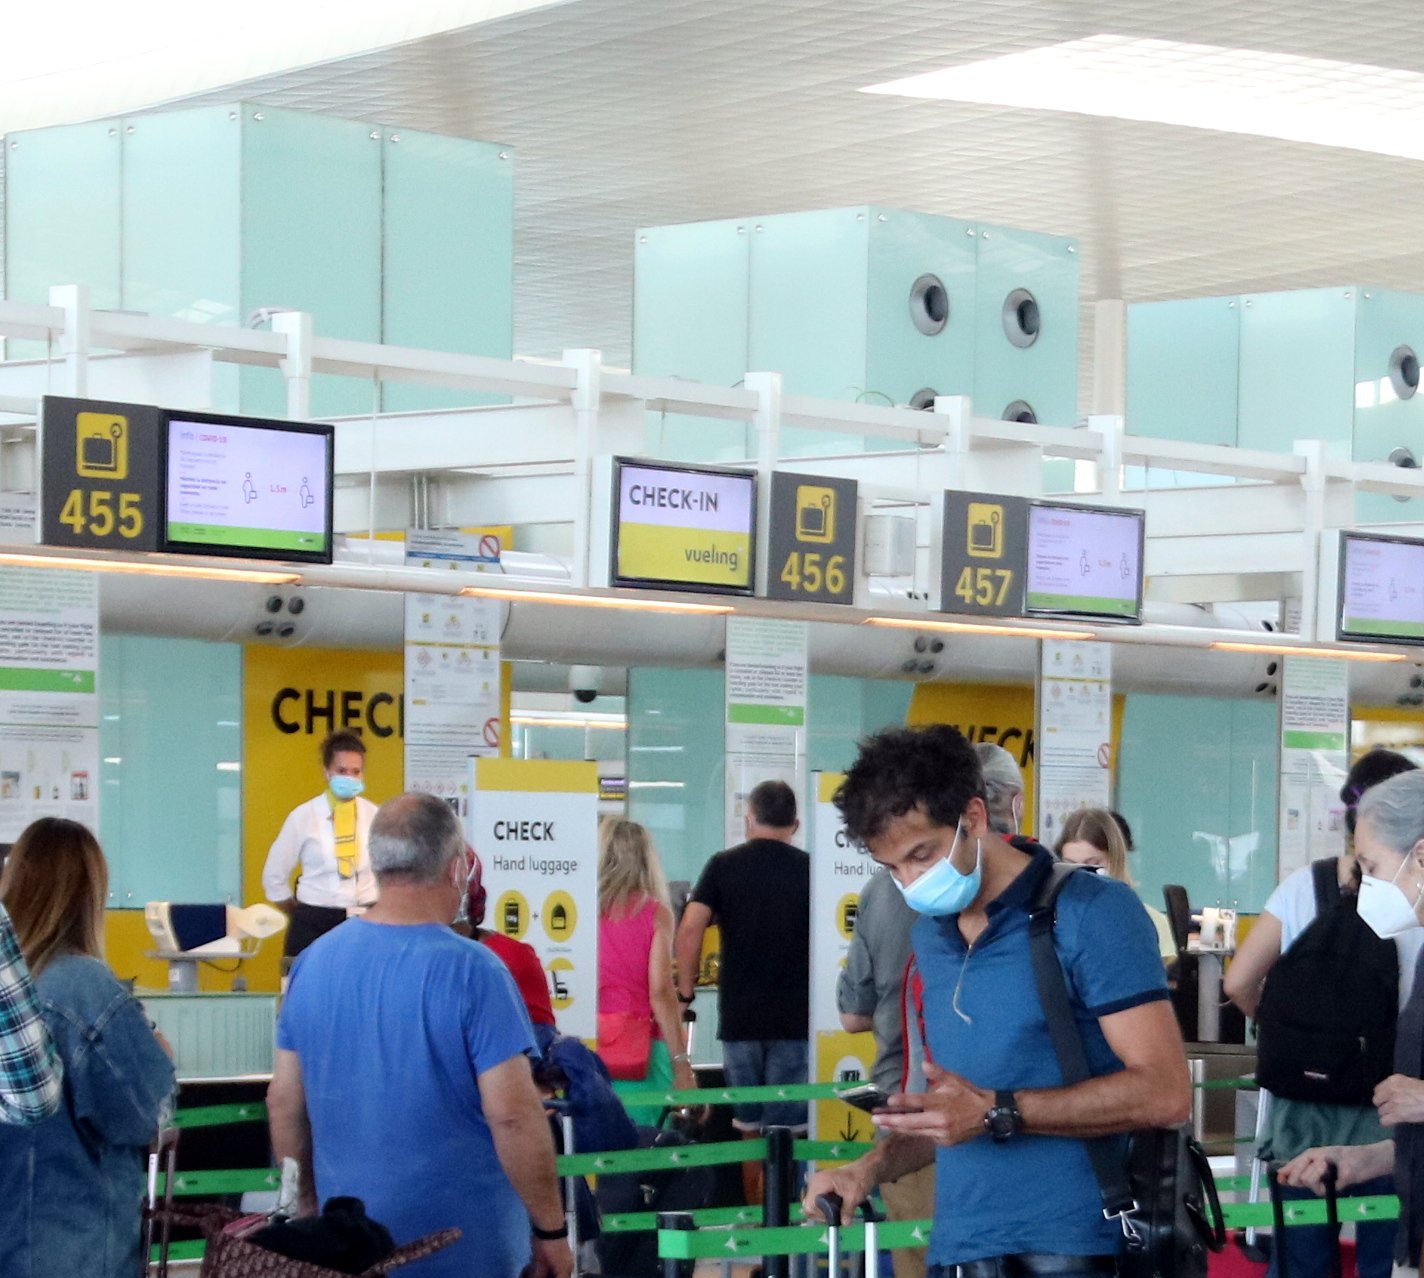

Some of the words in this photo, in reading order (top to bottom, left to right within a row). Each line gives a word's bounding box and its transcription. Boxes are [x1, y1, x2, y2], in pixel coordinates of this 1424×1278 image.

[58, 489, 145, 541] 455
[628, 484, 719, 514] CHECK-IN
[684, 545, 739, 571] vueling
[780, 552, 846, 595] 456
[954, 565, 1014, 607] 457
[270, 686, 404, 739] CHEC
[493, 820, 555, 842] CHECK
[492, 855, 528, 872] Hand
[530, 855, 578, 876] luggage
